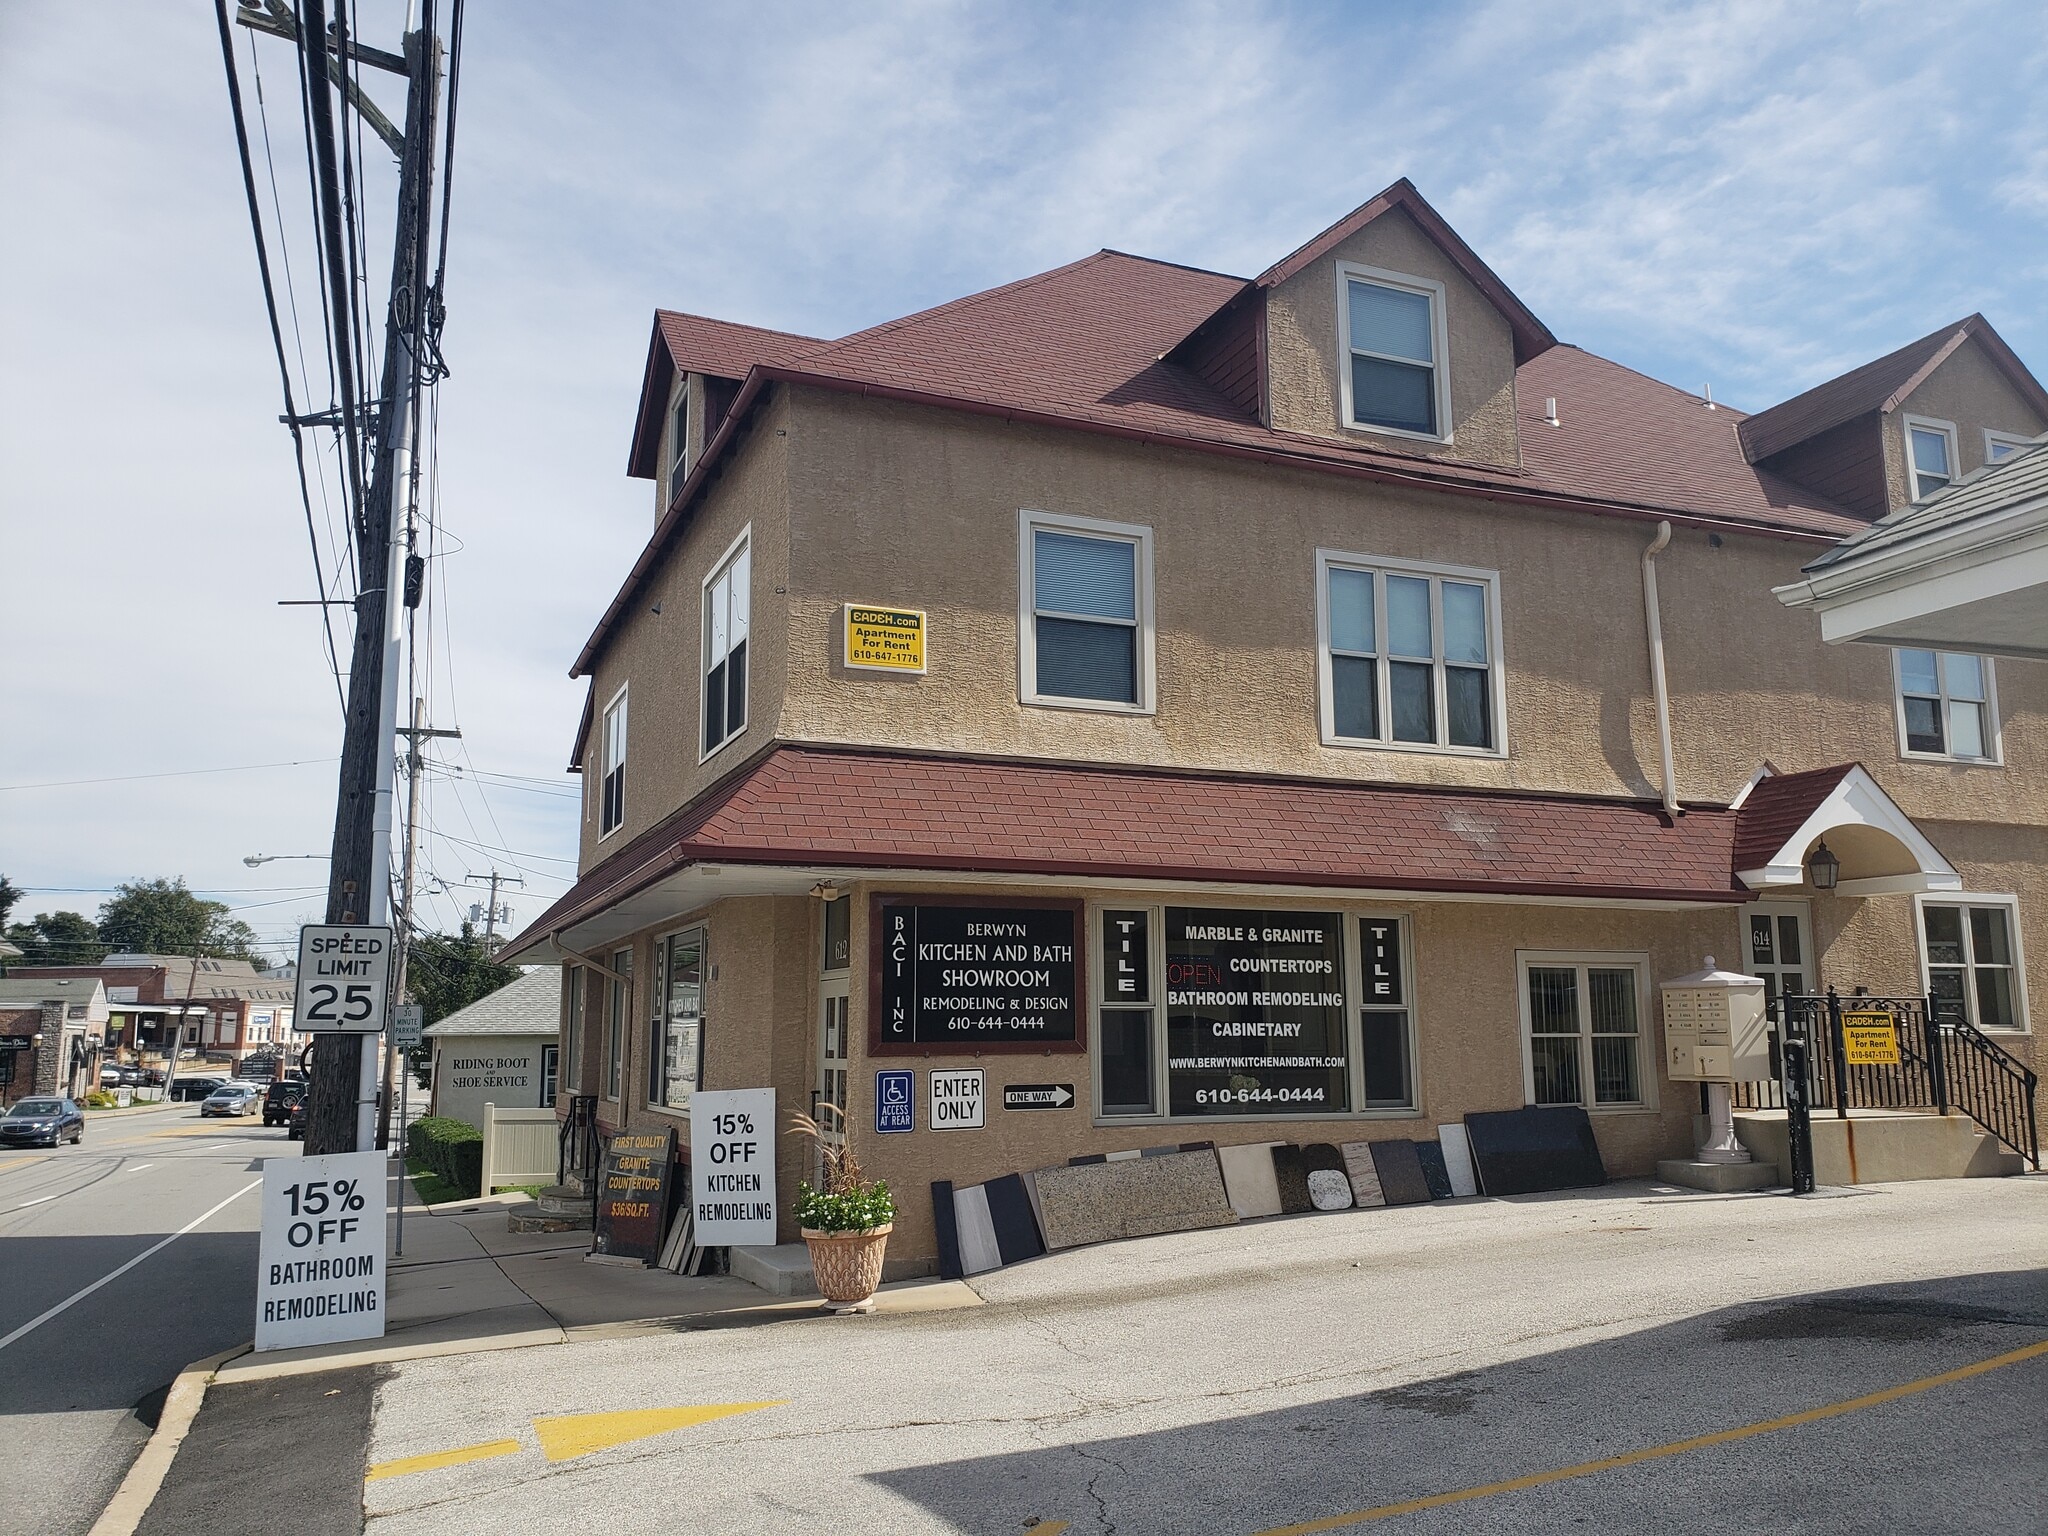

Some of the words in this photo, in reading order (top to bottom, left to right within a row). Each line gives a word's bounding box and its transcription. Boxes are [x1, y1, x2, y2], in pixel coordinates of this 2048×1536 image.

[853, 612, 918, 627] EADEH.com
[856, 628, 916, 640] Apartment
[862, 639, 880, 648] For
[884, 640, 911, 650] Rent
[854, 650, 918, 663] 610-647-1776
[967, 923, 1027, 937] BERWYN
[1185, 926, 1243, 941] MARBLE
[1248, 928, 1258, 942] &
[1262, 928, 1323, 943] GRANITE
[1753, 930, 1770, 946] 614
[310, 938, 383, 954] SPEED
[835, 939, 848, 961] 612
[892, 916, 907, 977] BACI
[919, 944, 986, 961] KITCHEN
[992, 945, 1028, 962] AND
[1033, 945, 1072, 962] BATH
[1116, 921, 1135, 991] TILE
[1371, 927, 1390, 994] TILE
[317, 960, 372, 976] LIMIT
[1230, 958, 1333, 974] COUNTERTOPS
[942, 970, 1050, 987] SHOWROOM
[1168, 964, 1222, 985] OPEN
[307, 984, 372, 1021] 25
[923, 997, 1005, 1010] REMODELING
[1009, 998, 1021, 1010] &
[1025, 997, 1069, 1010] DESIGN
[1168, 992, 1248, 1005] BATHROOM
[1252, 993, 1343, 1006] REMODELING
[403, 1009, 412, 1017] 30
[893, 997, 905, 1033] INC
[1846, 1016, 1890, 1026] EADEH.com
[948, 1016, 1045, 1030] 610-644-0444
[1212, 1023, 1301, 1037] CABINETARY
[1850, 1031, 1890, 1039] Apartment
[1856, 1040, 1867, 1048] For
[1870, 1040, 1887, 1048] Rent
[1169, 1057, 1345, 1069] WWW.BERWYNKITCHENANDBATH.COM
[1851, 1051, 1894, 1059] 610-647-1776
[453, 1058, 494, 1070] RIDING
[497, 1058, 530, 1069] BOOT
[452, 1077, 482, 1088] SHOE
[483, 1076, 528, 1087] SERVICE
[934, 1078, 980, 1098] ENTER
[1010, 1092, 1029, 1102] ONE
[1032, 1092, 1053, 1101] WAY
[1195, 1087, 1325, 1103] 610-644-0444
[881, 1104, 909, 1116] ACCESS
[938, 1101, 977, 1121] ONLY
[712, 1113, 754, 1135] 15%
[880, 1116, 890, 1126] AT
[891, 1115, 911, 1126] REAR
[614, 1136, 635, 1148] FIRST
[635, 1135, 667, 1148] QUALITY
[710, 1142, 757, 1164] OFF
[619, 1157, 650, 1170] GRANITE
[608, 1176, 661, 1191] COUNTERTOPS
[707, 1174, 761, 1192] KITCHEN
[283, 1179, 365, 1216] 15%
[611, 1202, 650, 1217] $36/SQ.FT.
[699, 1203, 772, 1221] REMODELING
[287, 1217, 359, 1248] OFF
[270, 1255, 374, 1286] BATHROOM
[264, 1290, 377, 1323] REMODELING
